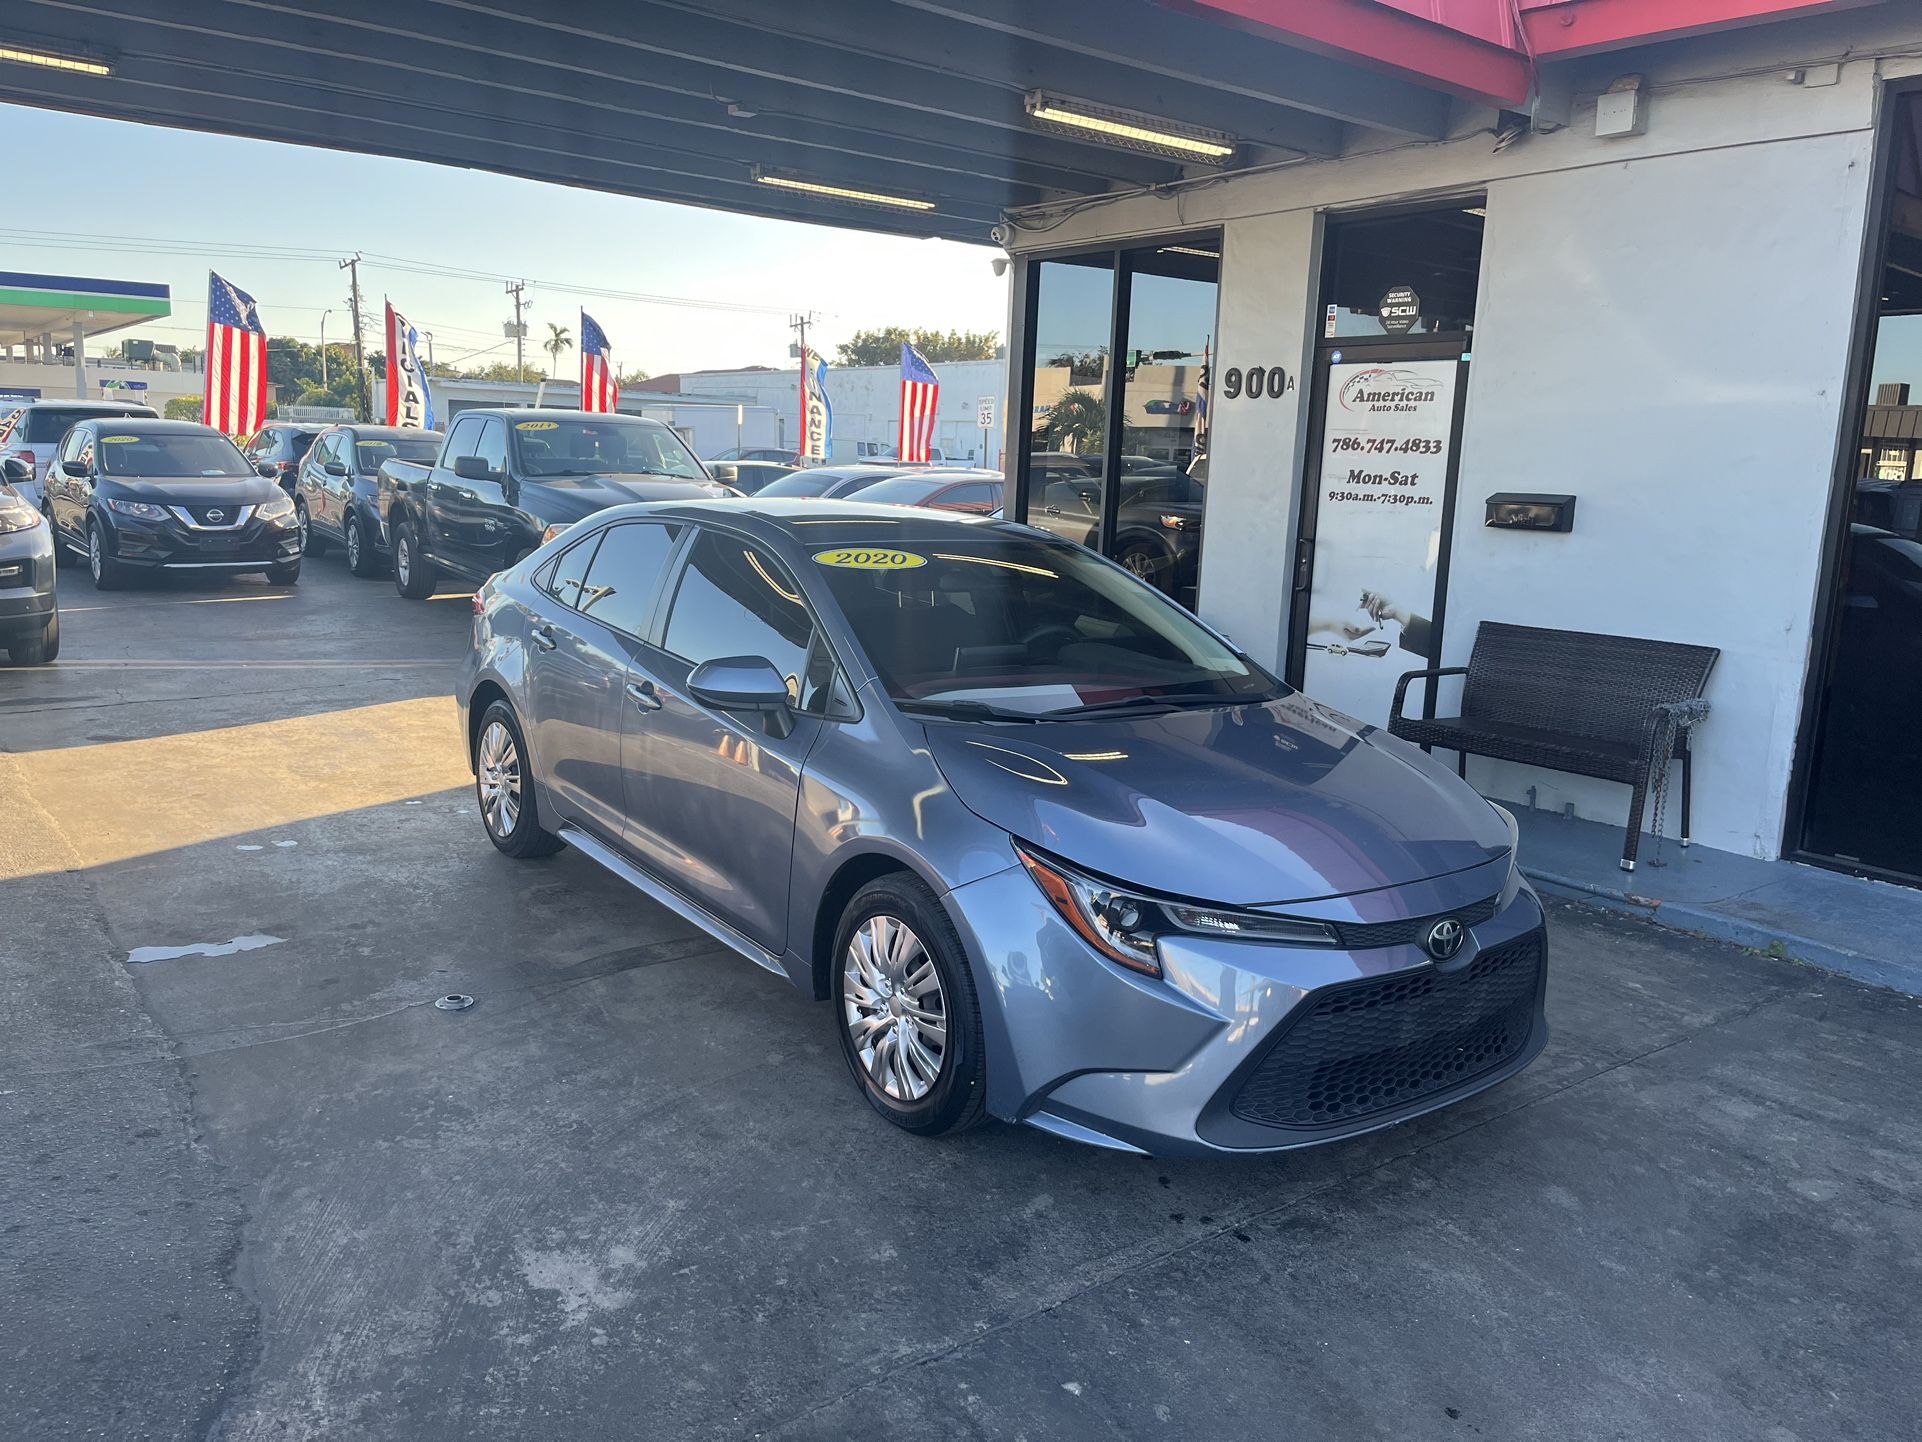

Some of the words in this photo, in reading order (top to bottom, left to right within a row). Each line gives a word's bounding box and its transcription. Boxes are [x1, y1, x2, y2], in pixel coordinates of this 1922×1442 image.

[1390, 306, 1416, 316] SCW
[1223, 366, 1286, 400] 900
[1286, 375, 1295, 391] A
[1352, 387, 1435, 403] American
[809, 368, 823, 456] INANCE
[1368, 403, 1392, 412] Auto
[1393, 403, 1418, 412] Sales
[980, 412, 992, 425] 35
[1331, 437, 1443, 455] 786.747.4833
[1346, 469, 1419, 487] Mon-Sat
[1328, 491, 1433, 506] 9:30a.m.-7:30p.m.
[834, 552, 908, 565] 2020
